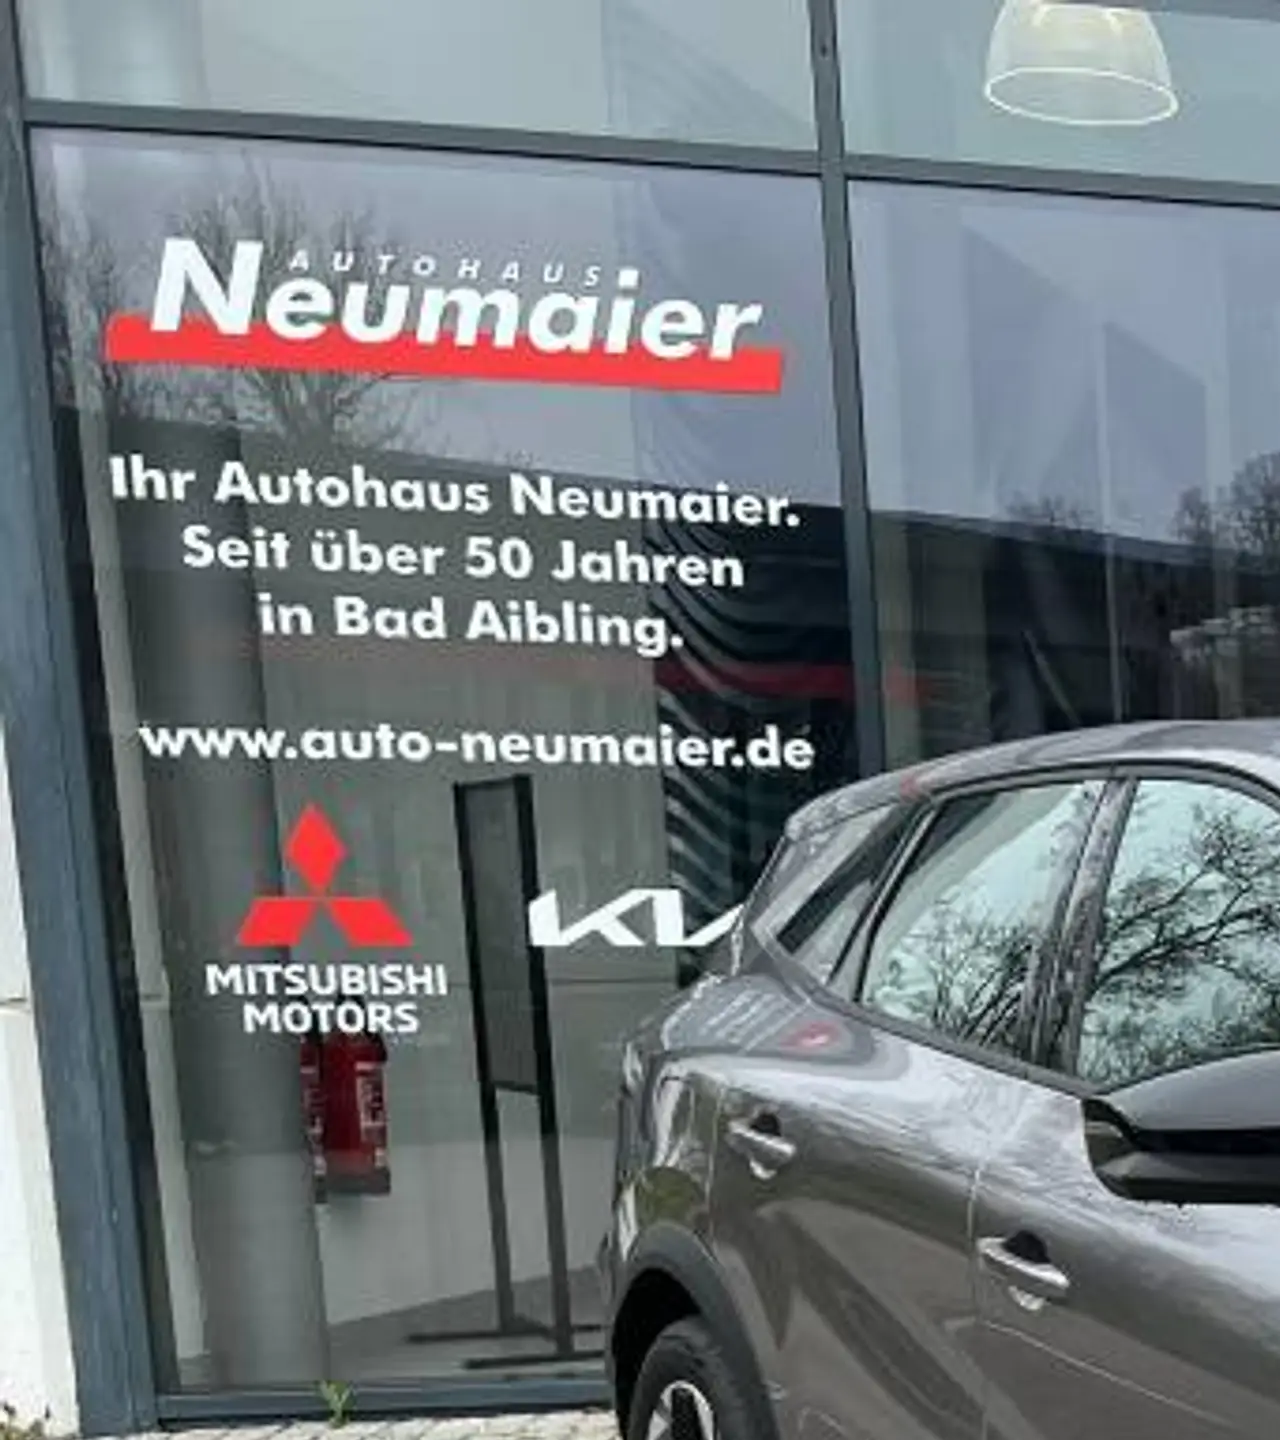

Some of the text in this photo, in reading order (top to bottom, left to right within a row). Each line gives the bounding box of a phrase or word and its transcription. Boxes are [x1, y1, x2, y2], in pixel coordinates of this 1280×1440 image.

[287, 248, 601, 288] AUTOHAUS
[150, 236, 764, 362] Neumaier
[110, 455, 801, 528] Ihr Autohaus Neumaier.
[182, 525, 745, 588] Seit über 50 Jahren
[257, 592, 684, 658] in Bad Aibling.
[138, 722, 816, 770] www.auto-neumaier.de
[206, 964, 448, 997] MITSUBISHI
[243, 1003, 419, 1034] MOTORS
